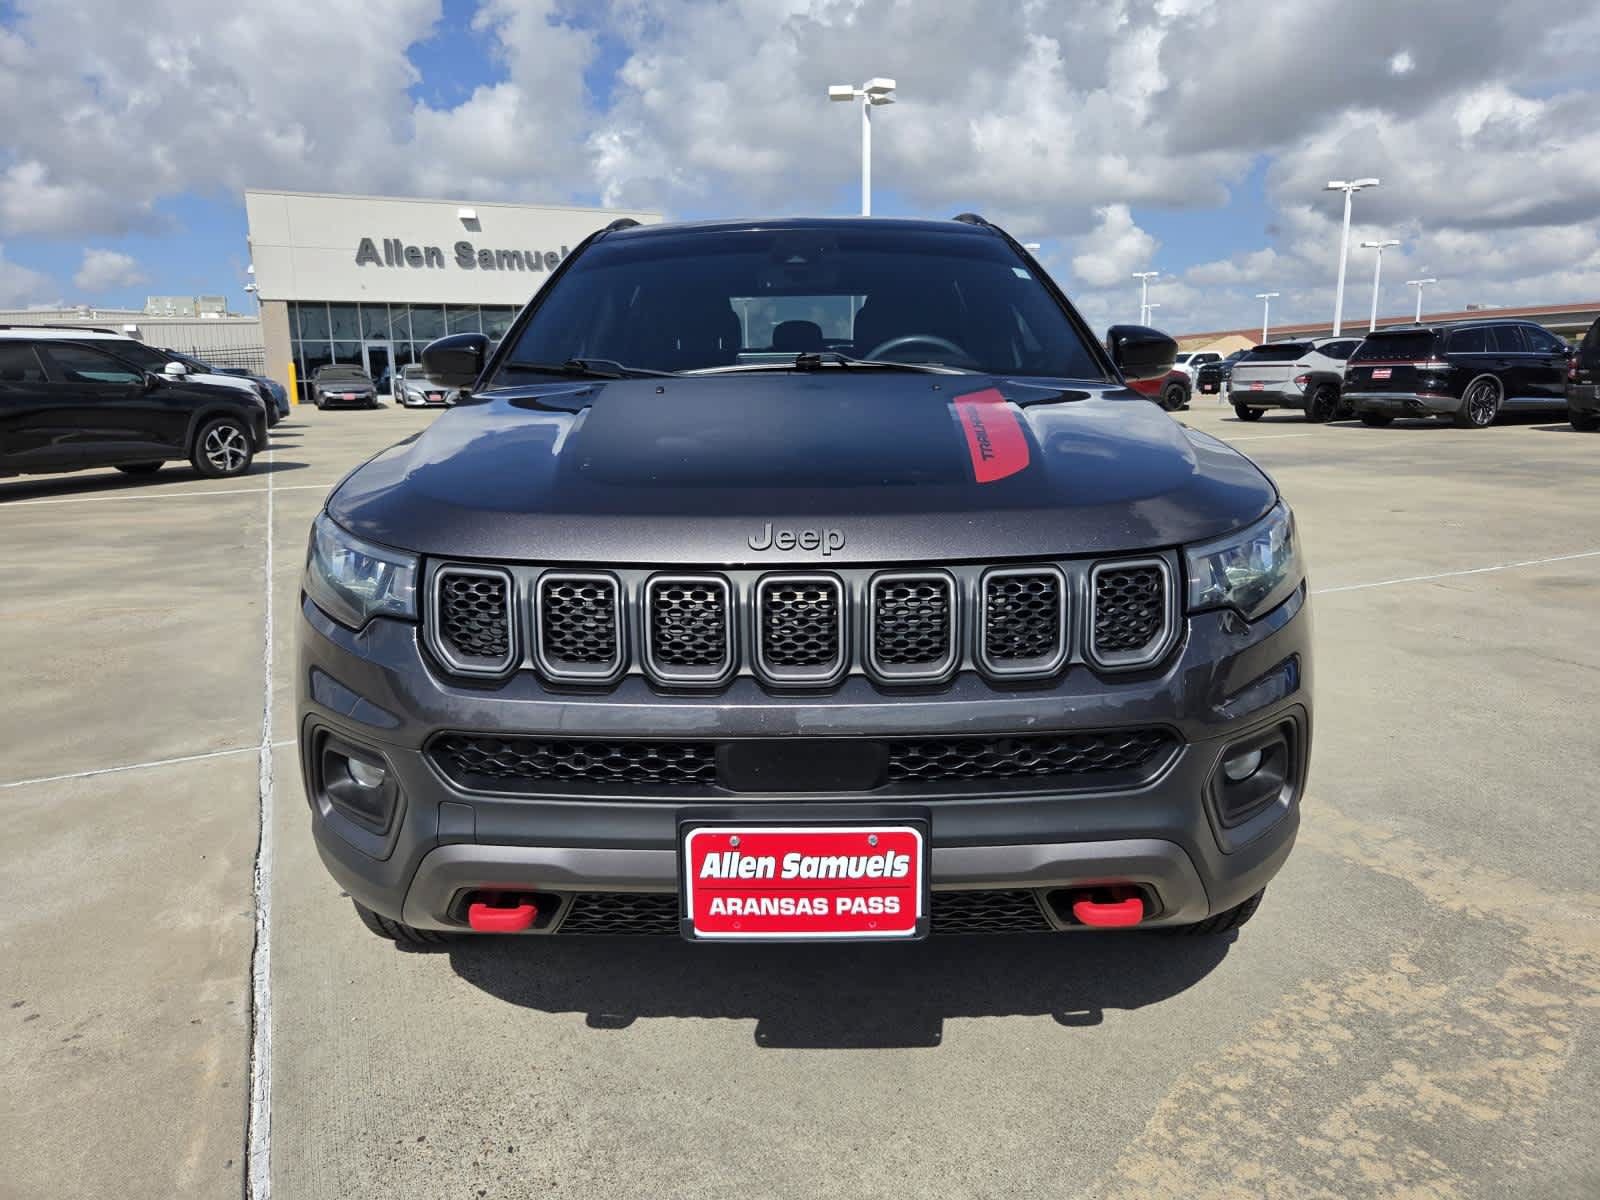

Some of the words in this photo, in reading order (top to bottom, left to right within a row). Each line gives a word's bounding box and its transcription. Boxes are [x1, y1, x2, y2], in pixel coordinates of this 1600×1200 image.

[355, 237, 445, 269] Allen
[967, 402, 994, 461] TRAIL
[747, 522, 846, 556] Jeep
[700, 852, 775, 879] Allen
[781, 851, 910, 878] Samuels
[709, 897, 829, 916] ARANSAS
[836, 896, 901, 915] PASS
